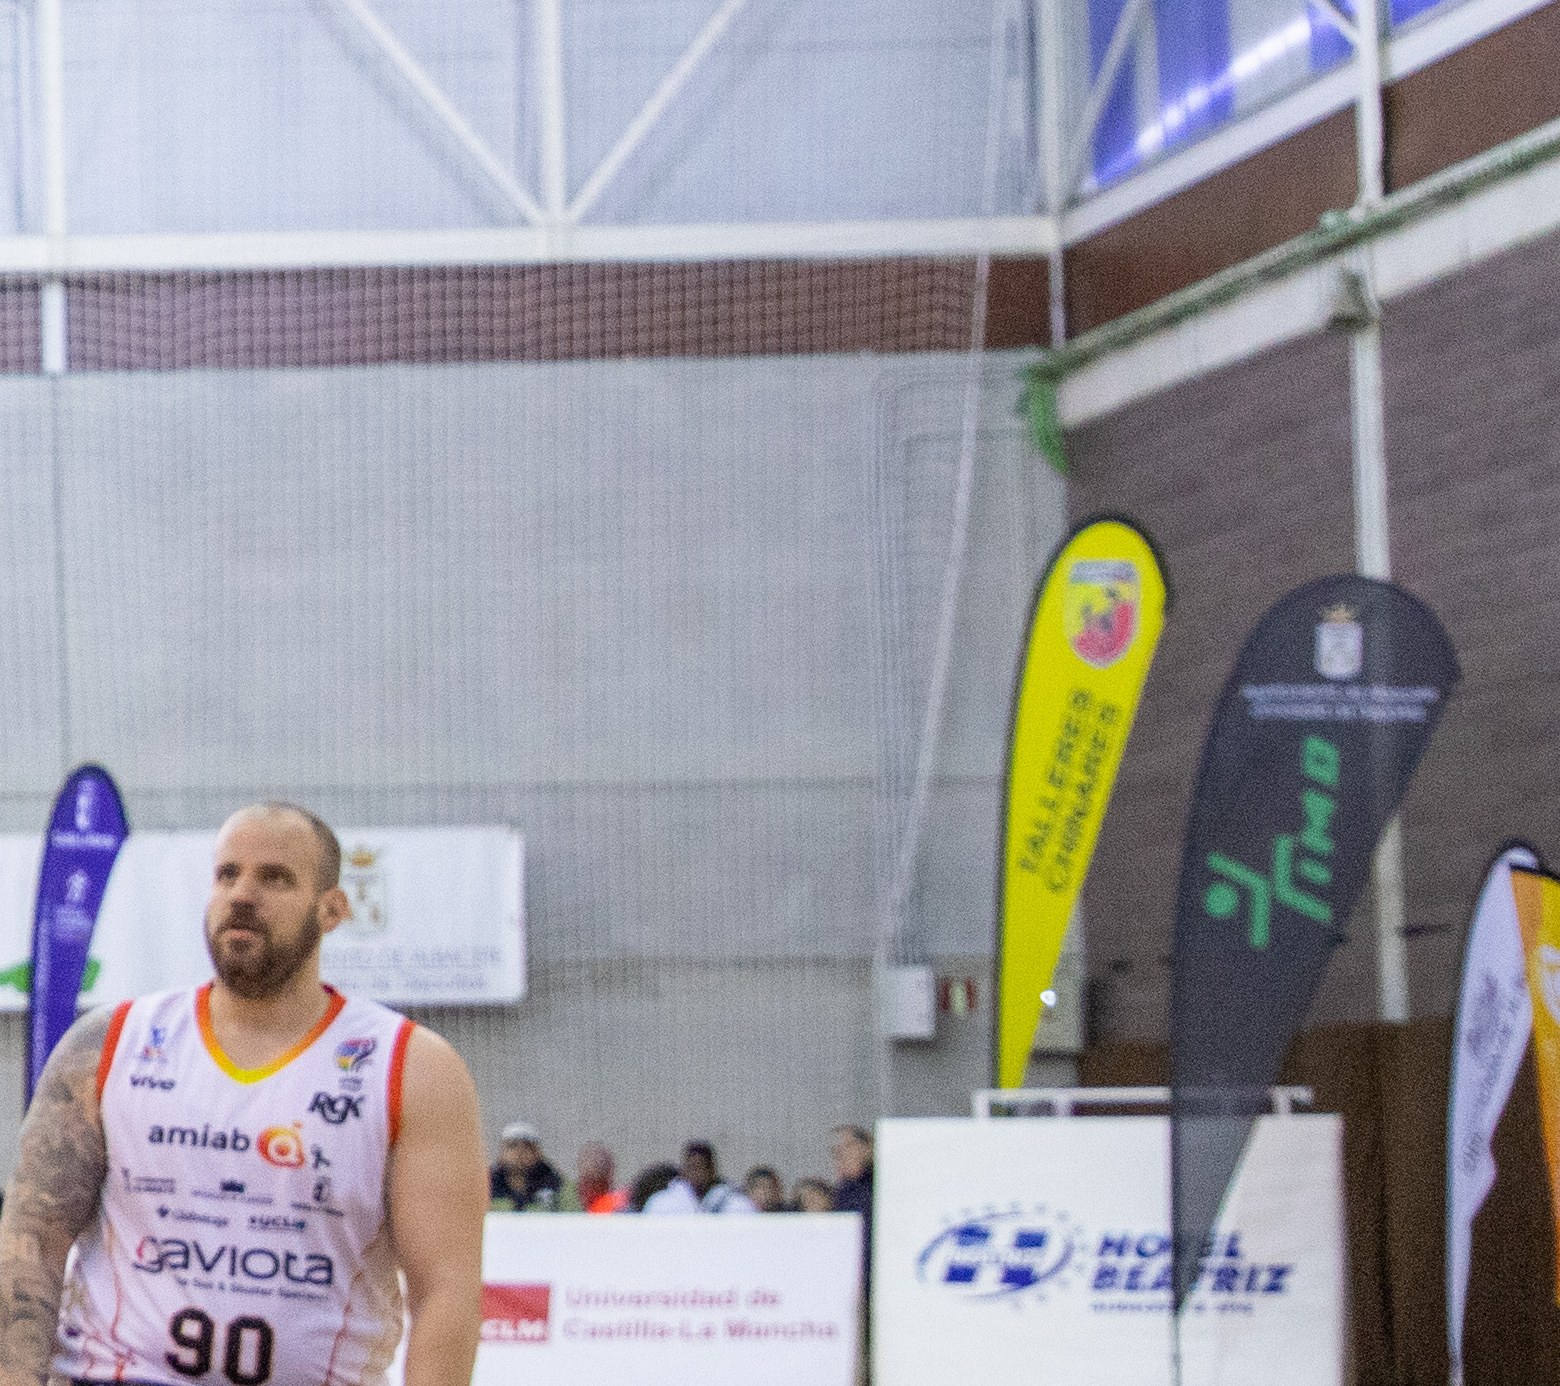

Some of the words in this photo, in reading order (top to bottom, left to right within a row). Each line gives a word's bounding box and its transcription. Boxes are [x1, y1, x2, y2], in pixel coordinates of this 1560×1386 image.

[148, 1123, 251, 1153] amiab
[1092, 1262, 1295, 1293] BEARIZ
[566, 1287, 738, 1310] Universidad
[747, 1287, 781, 1309] de
[480, 1317, 548, 1340] CLM
[724, 1316, 839, 1341] Mancha
